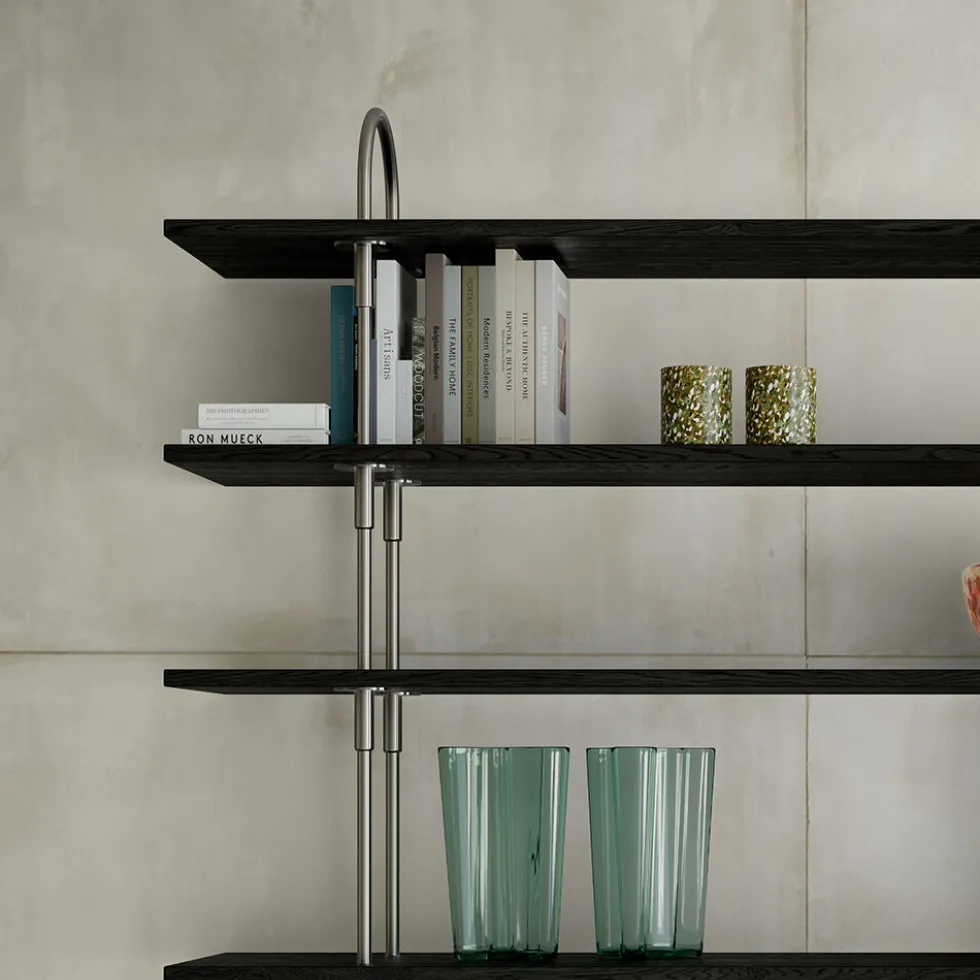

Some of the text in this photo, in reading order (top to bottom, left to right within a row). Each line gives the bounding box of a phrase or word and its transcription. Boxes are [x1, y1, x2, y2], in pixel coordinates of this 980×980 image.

[383, 328, 394, 380] Artisans
[432, 326, 440, 352] Belgian
[414, 354, 423, 418] WOODCUT
[189, 434, 263, 444] RON MUECK
